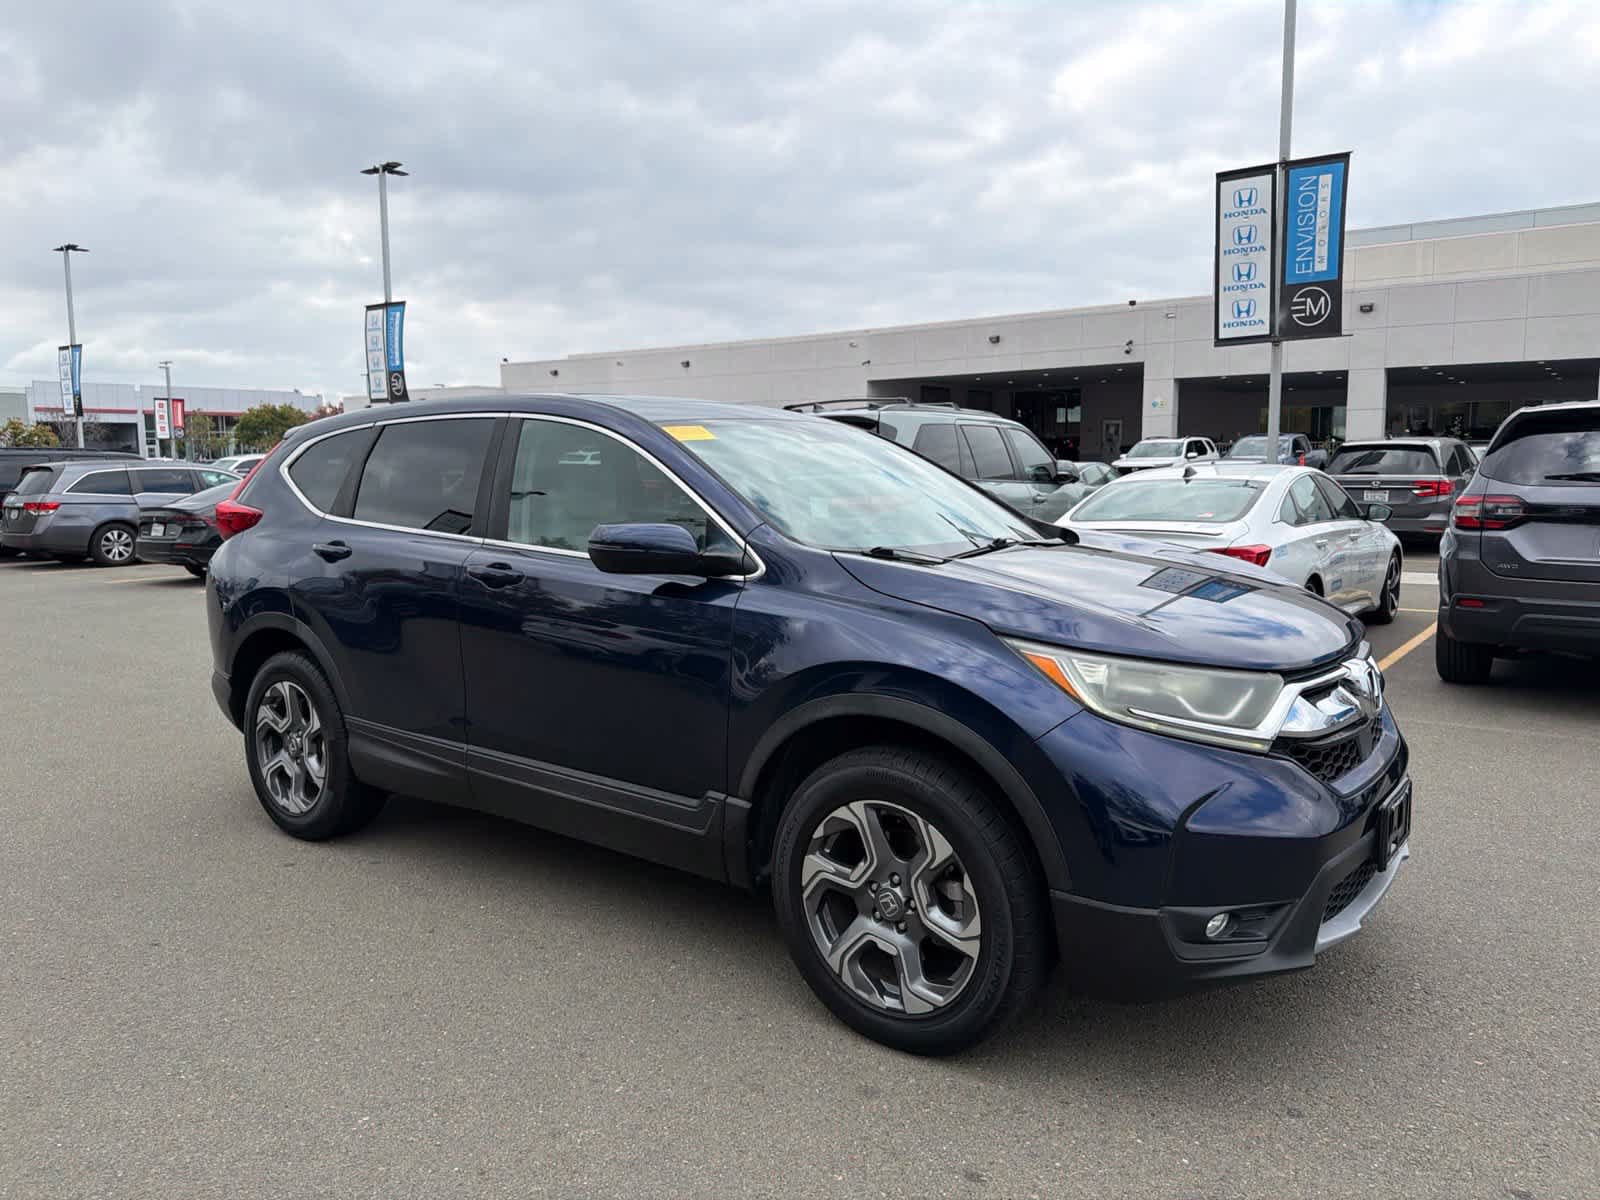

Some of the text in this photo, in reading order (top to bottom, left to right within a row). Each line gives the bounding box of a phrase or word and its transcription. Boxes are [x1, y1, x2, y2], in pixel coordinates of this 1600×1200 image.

[1224, 208, 1268, 218] HONDA
[1295, 175, 1317, 274] ENVISION
[1224, 245, 1267, 255] HONDA
[1223, 282, 1267, 292] HONDA
[1223, 319, 1265, 328] HONDA
